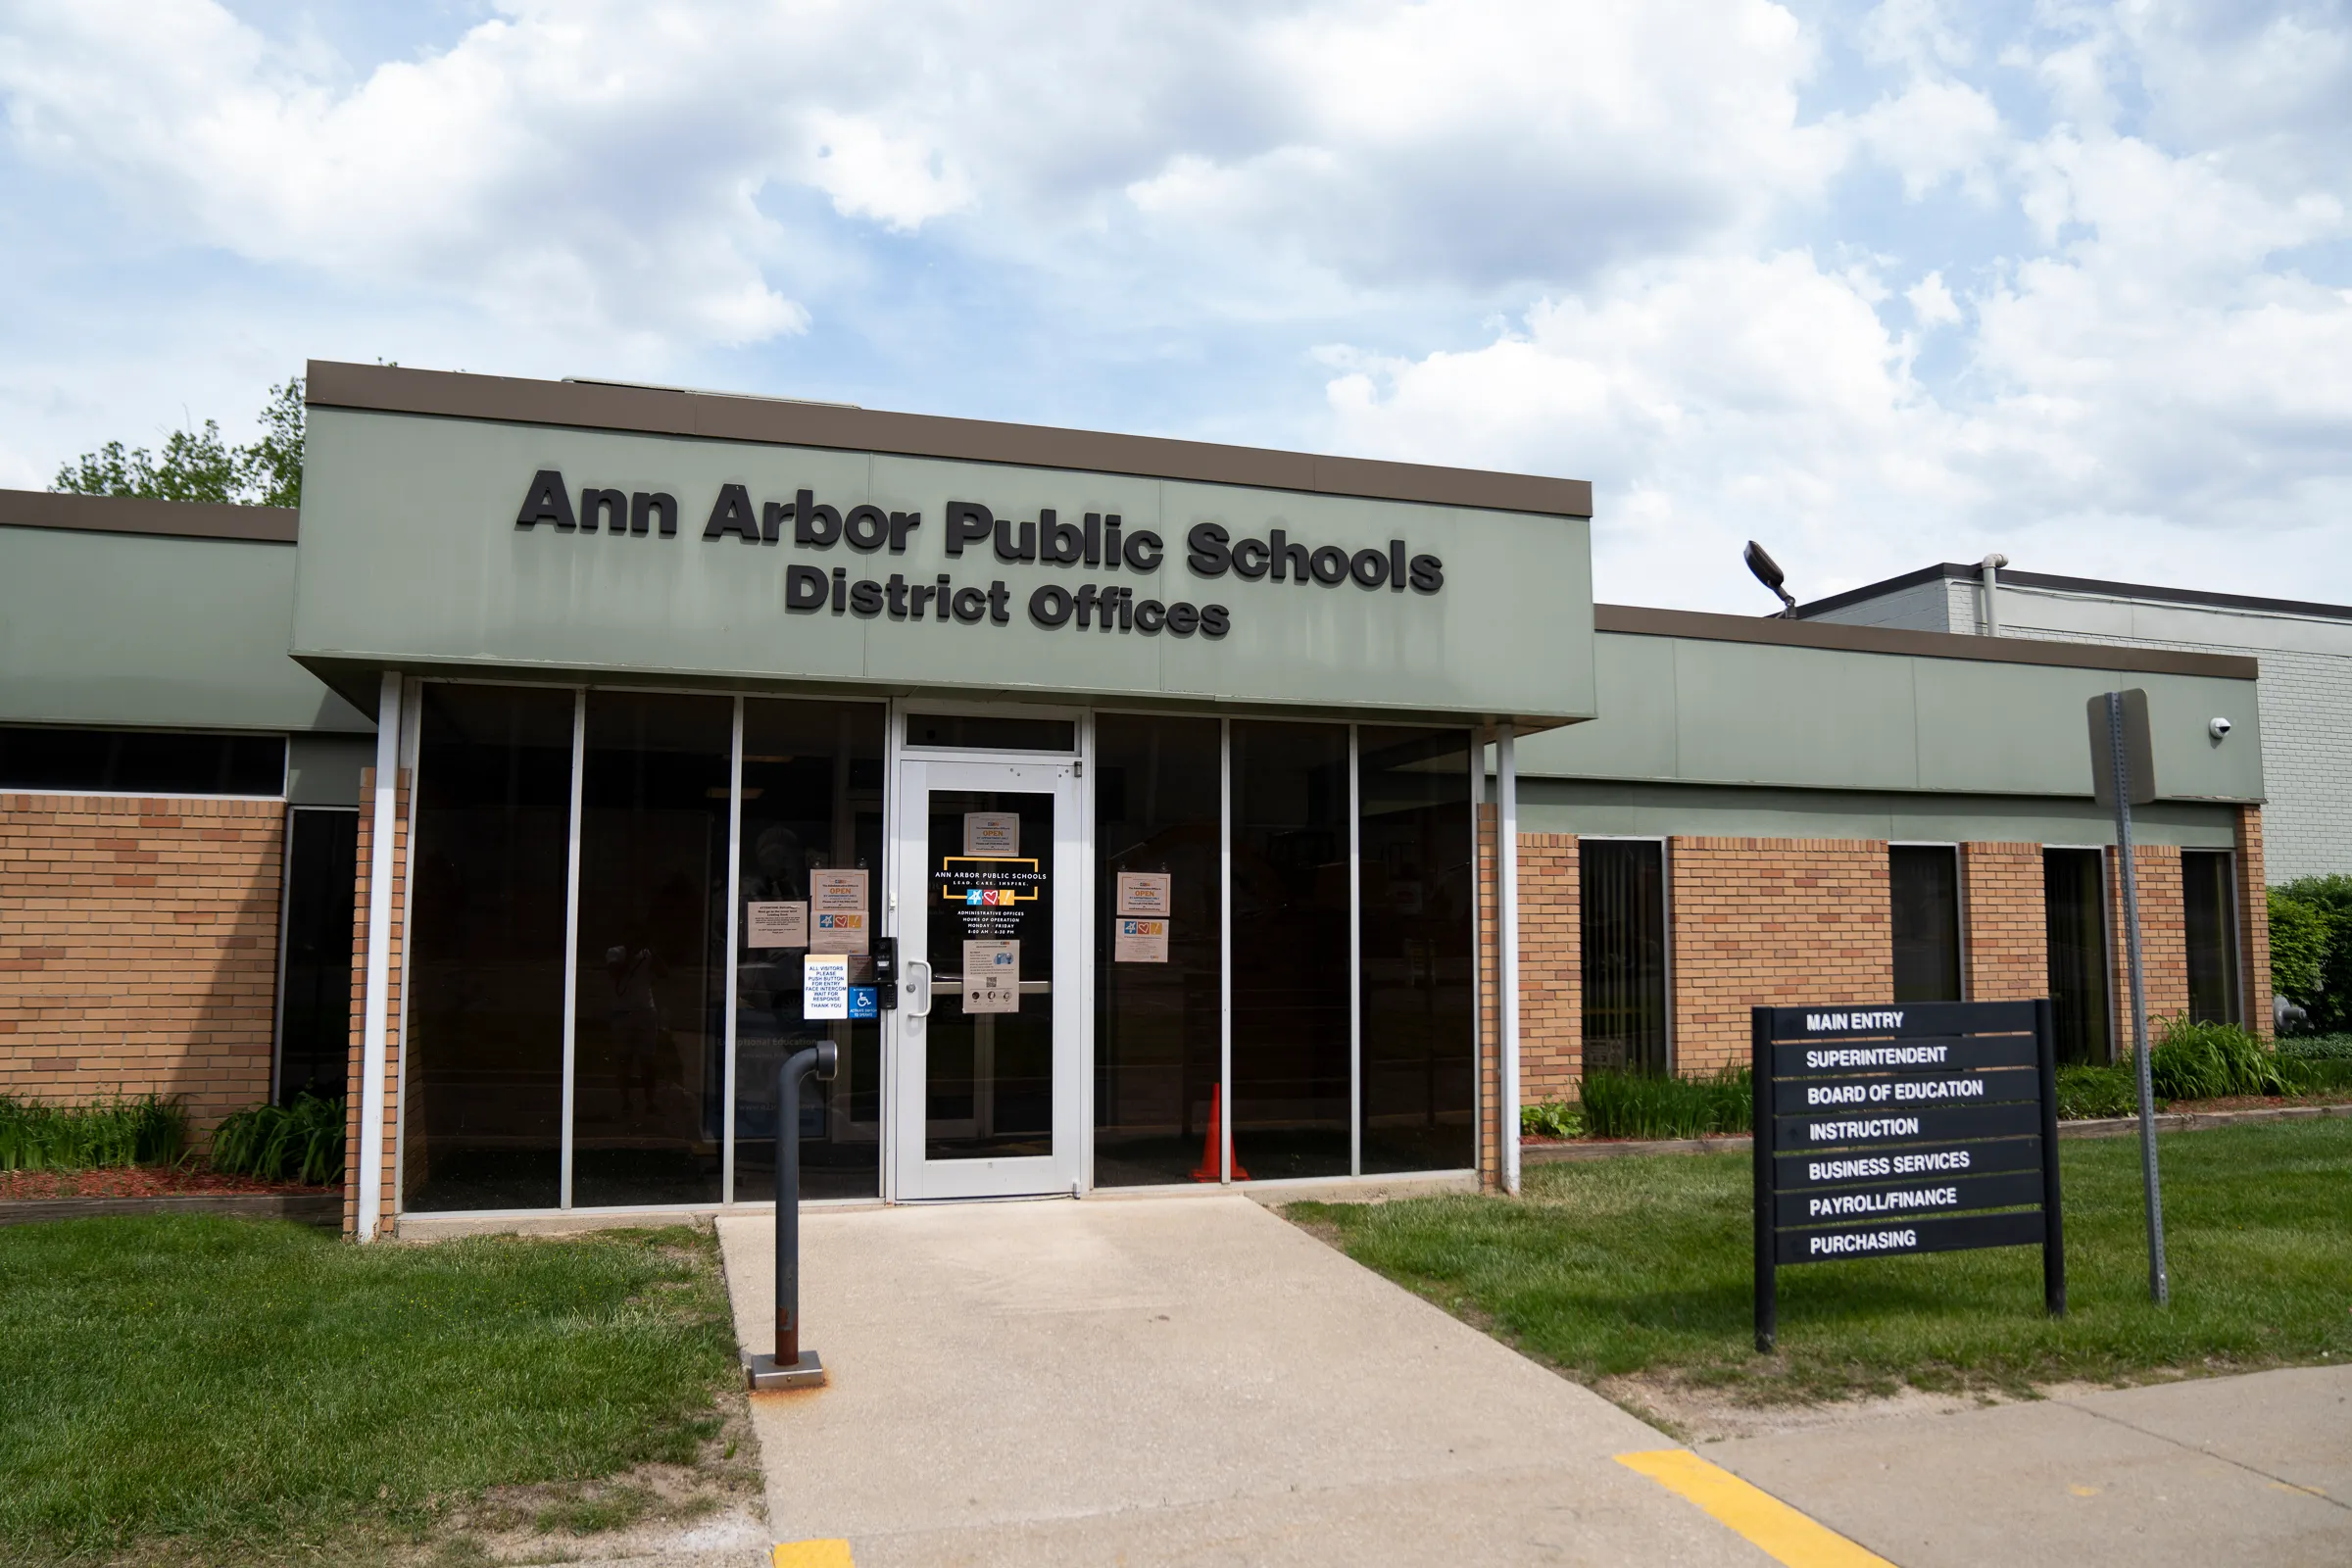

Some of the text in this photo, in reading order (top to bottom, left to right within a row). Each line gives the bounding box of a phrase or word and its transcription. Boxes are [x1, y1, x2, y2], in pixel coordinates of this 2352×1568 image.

[516, 470, 1445, 592] Ann Arbor Public Schools
[787, 564, 1231, 636] District Offices
[1806, 1011, 1904, 1031] MAIN ENTRY
[1806, 1046, 1948, 1068] SUPERINTENDENT
[1808, 1079, 1984, 1104] BOARD OF EDUCATION
[1810, 1117, 1919, 1141] INSTRUCTION
[1809, 1151, 1971, 1181] BUSINESS SERVICES
[1810, 1187, 1957, 1216] PAYROLL/FINANCE
[1811, 1229, 1917, 1254] PURCHASING
